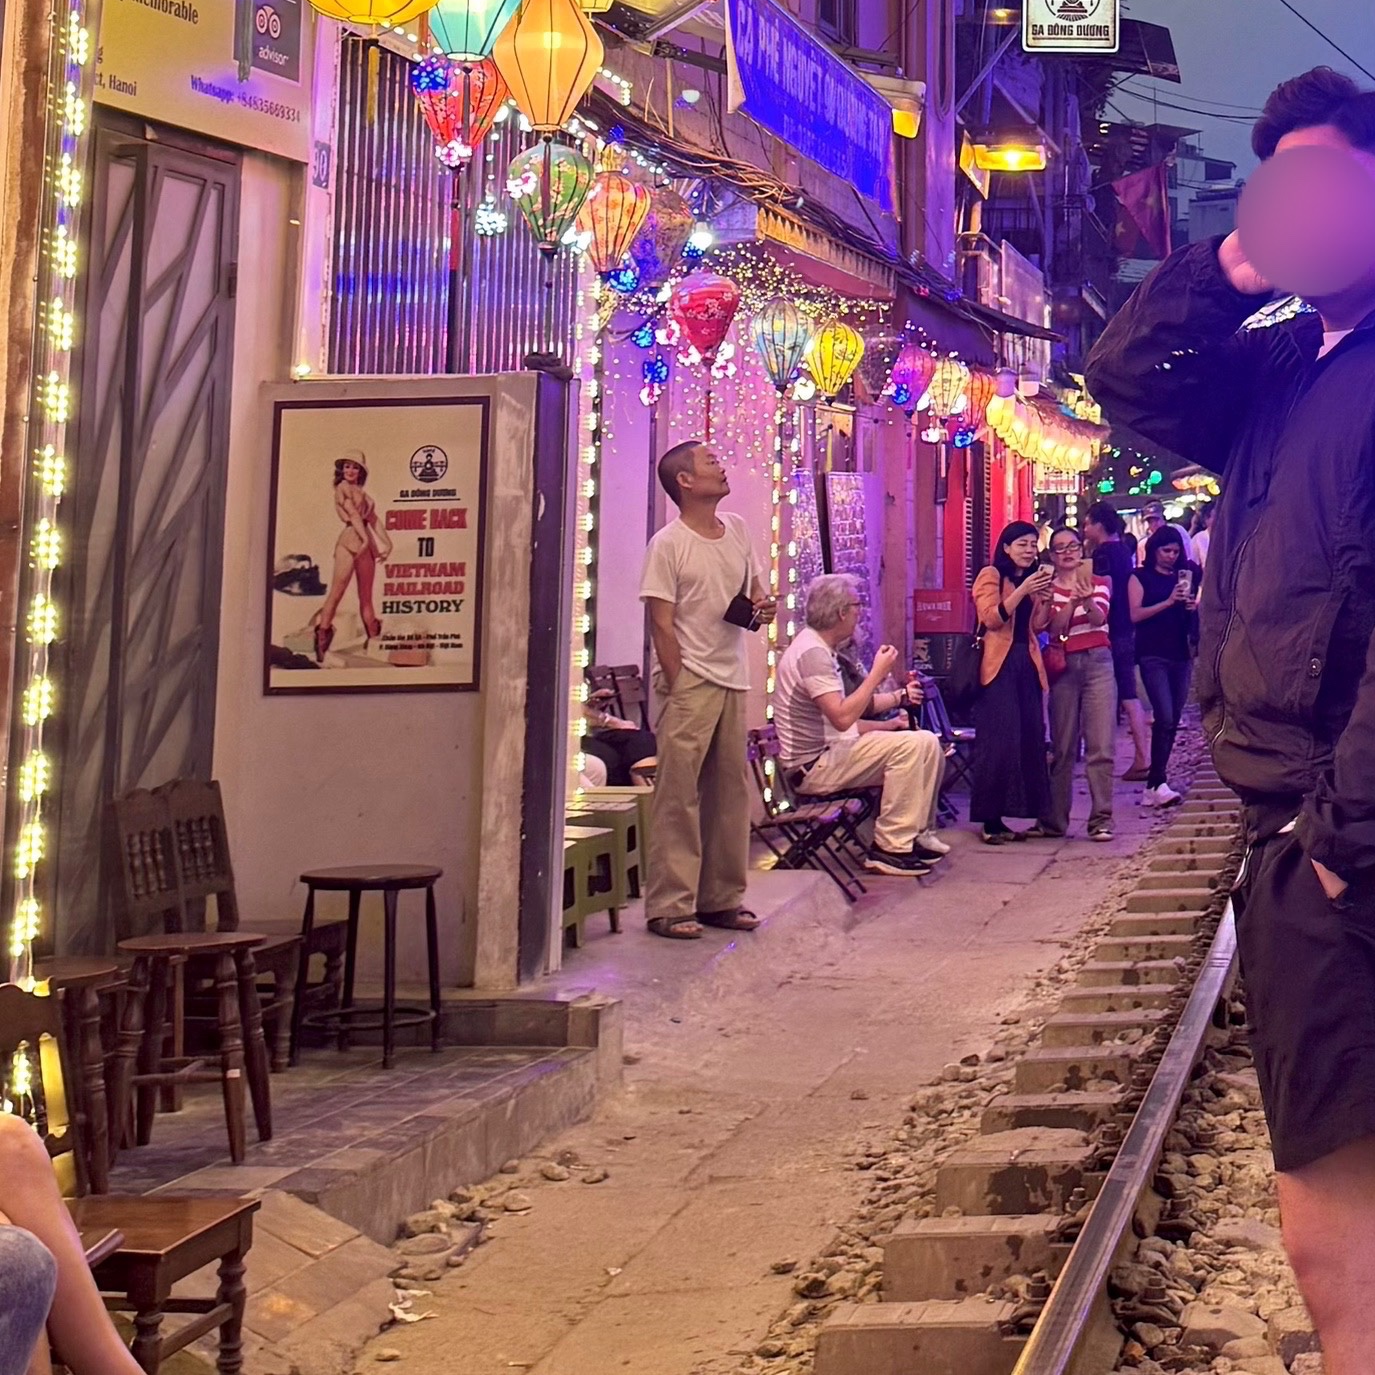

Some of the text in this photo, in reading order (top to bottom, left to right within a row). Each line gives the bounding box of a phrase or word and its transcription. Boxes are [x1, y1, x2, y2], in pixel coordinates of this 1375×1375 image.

[1031, 24, 1045, 37] GA
[108, 73, 137, 97] Hanoi
[385, 508, 468, 532] COME BACK
[417, 536, 435, 558] TO
[384, 561, 467, 580] VIETNAM
[383, 581, 465, 597] RAILROAD
[381, 599, 465, 615] HISTORY
